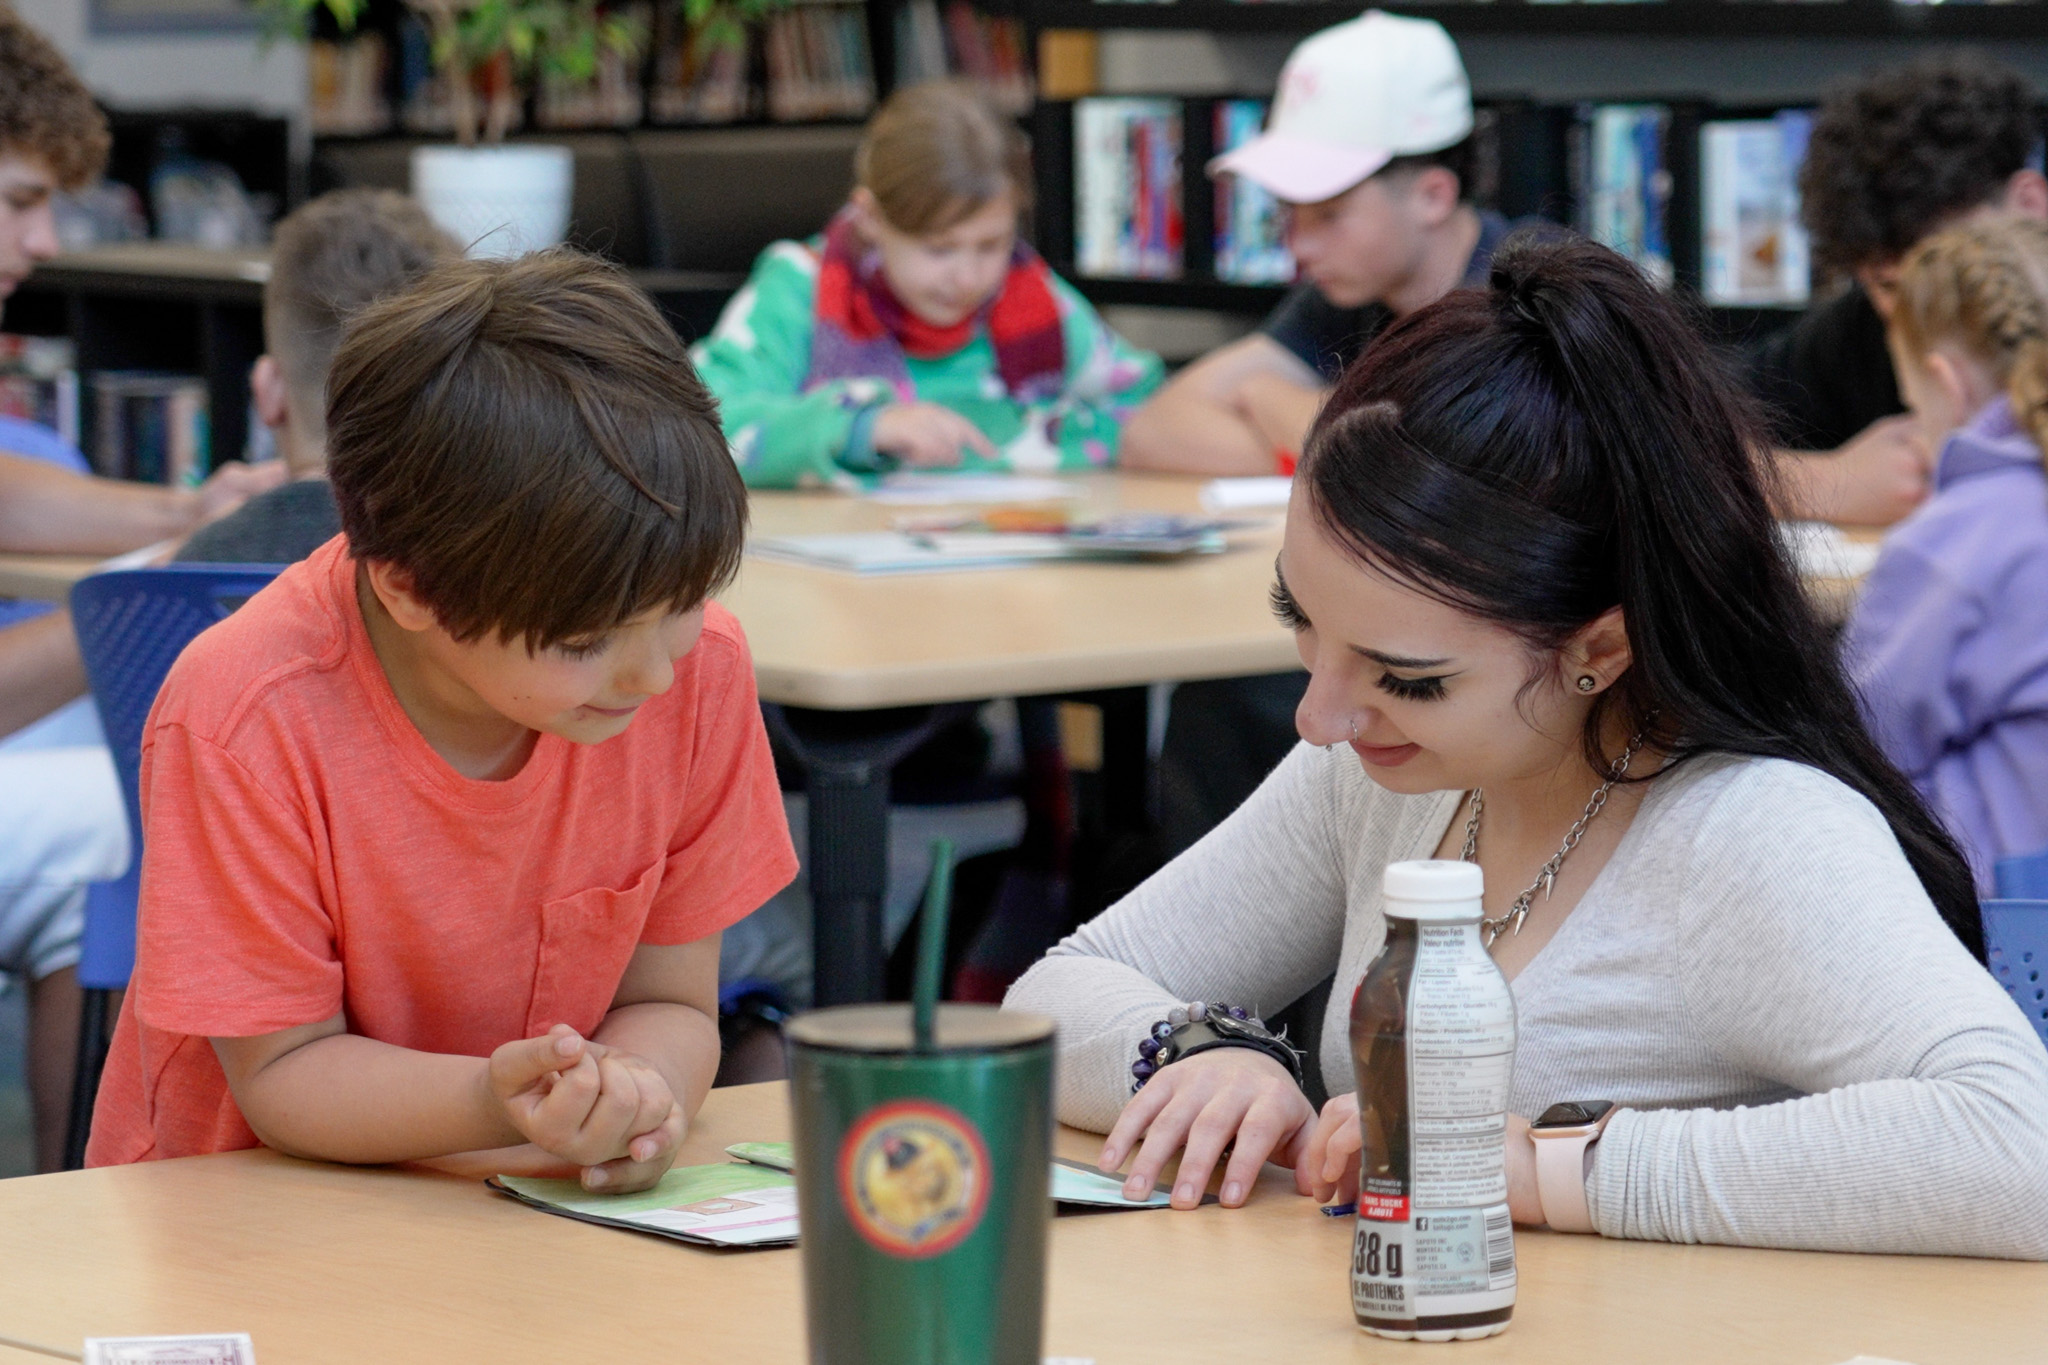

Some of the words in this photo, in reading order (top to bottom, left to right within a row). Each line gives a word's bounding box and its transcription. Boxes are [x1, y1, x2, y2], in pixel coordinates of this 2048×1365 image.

[1423, 927, 1449, 937] Nutrition
[1424, 939, 1442, 948] Valeur
[1380, 1198, 1403, 1208] SUCRE
[1356, 1229, 1382, 1277] 38
[1386, 1243, 1404, 1278] g
[1360, 1281, 1405, 1301] PROTÉINES
